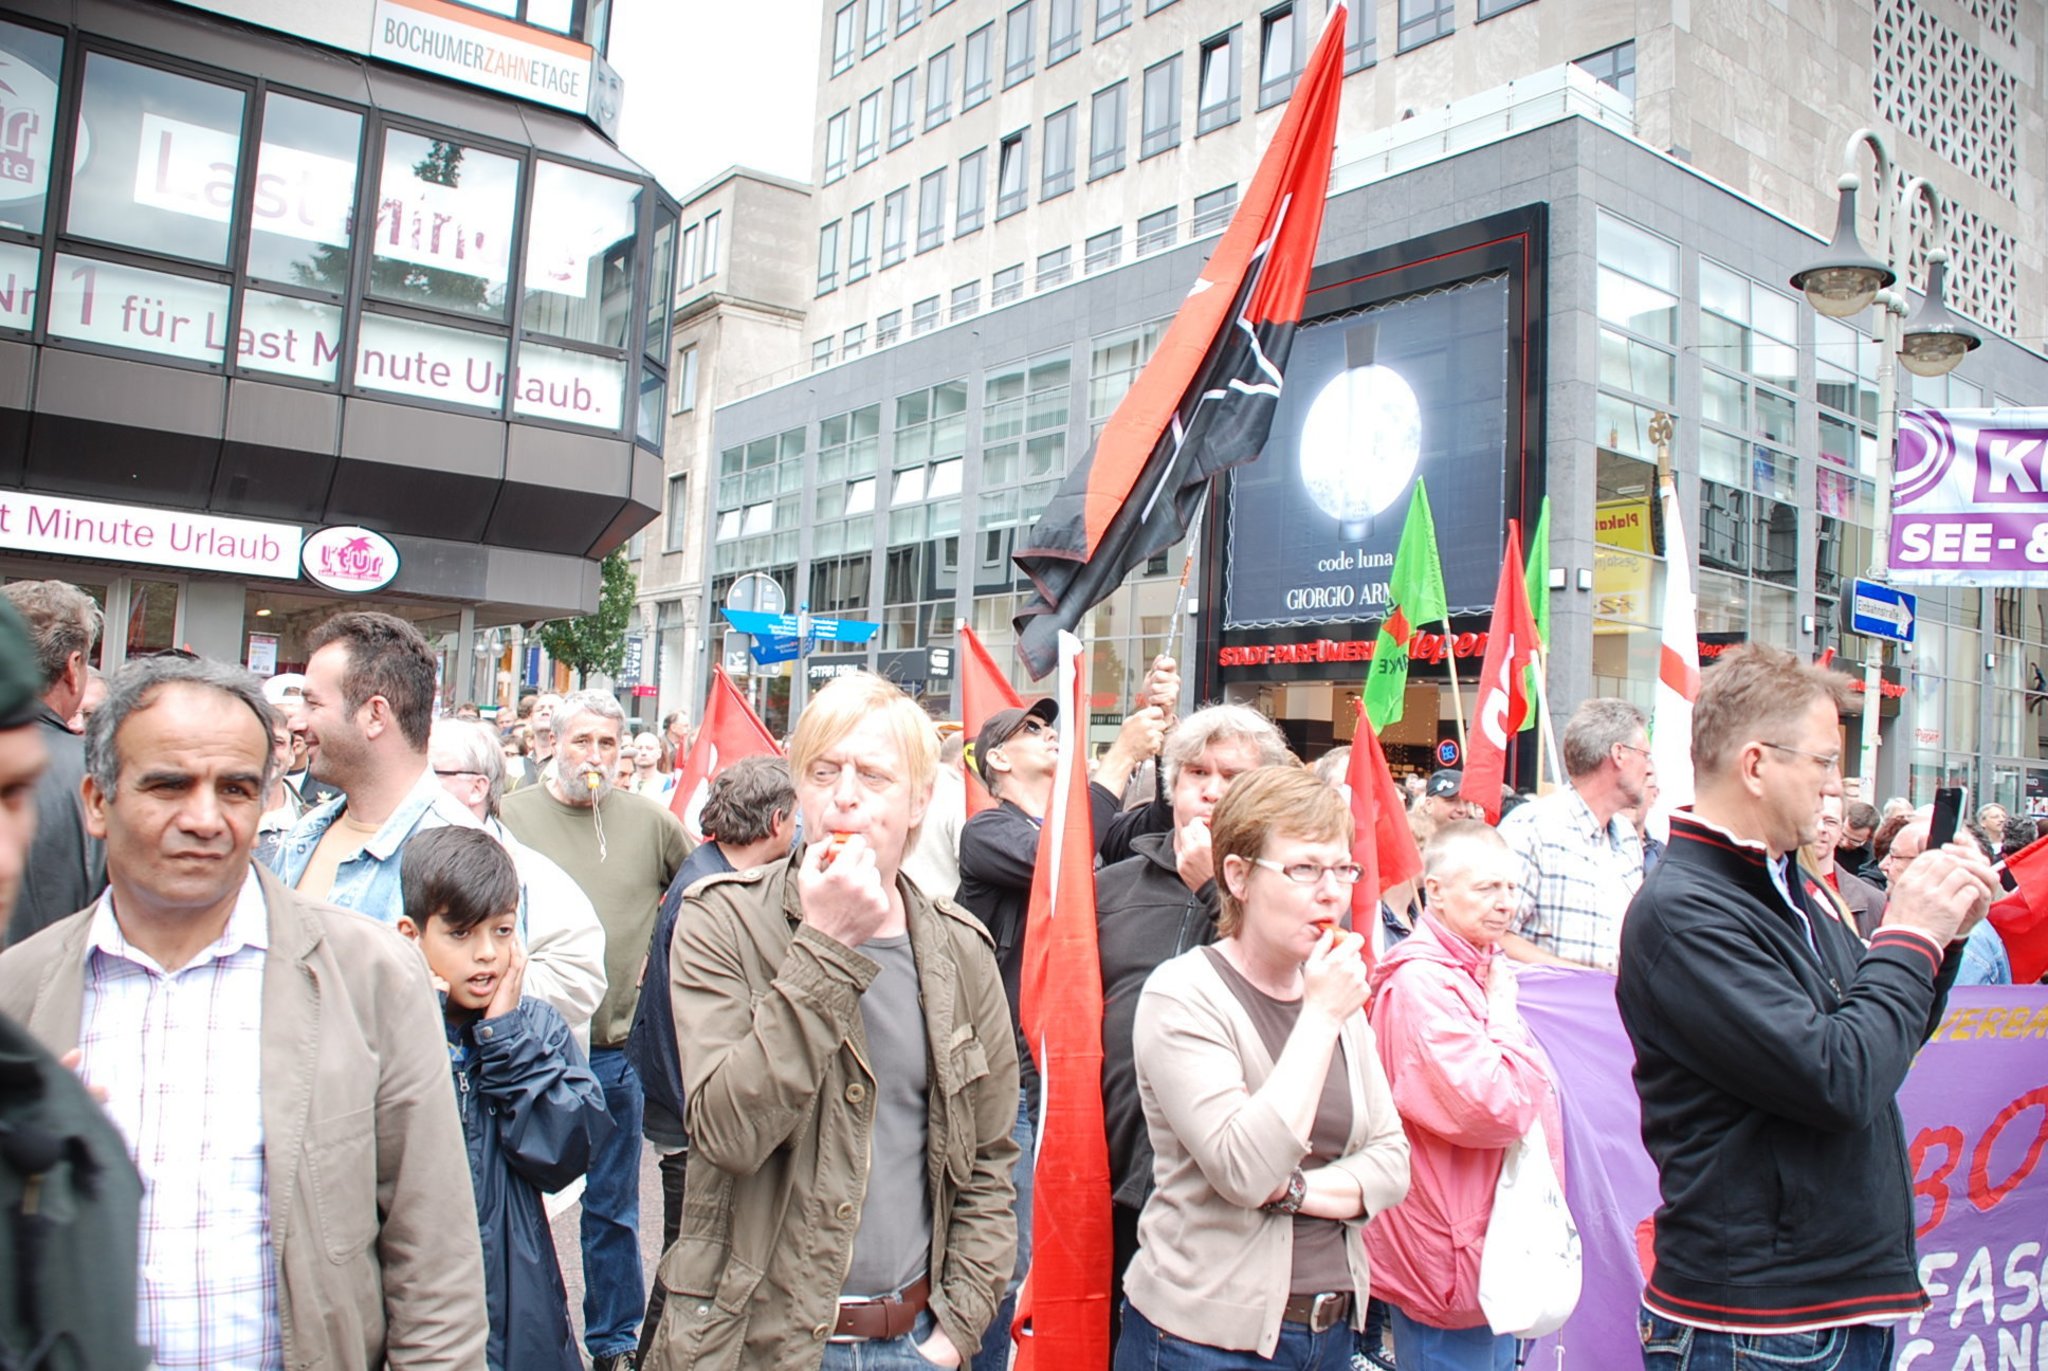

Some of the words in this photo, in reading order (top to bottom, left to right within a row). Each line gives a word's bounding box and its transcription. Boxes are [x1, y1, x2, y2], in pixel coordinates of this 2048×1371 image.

[384, 17, 580, 97] BOCHUMERZAHNETAGE
[71, 264, 97, 326] 1
[121, 294, 191, 343] für
[205, 312, 298, 363] Last
[313, 331, 451, 388] Mnute
[1988, 439, 2048, 494] K
[27, 505, 155, 548] Minute
[170, 522, 281, 562] Urlaub
[1318, 550, 1354, 573] code
[1358, 548, 1394, 569] luna
[1286, 584, 1355, 610] GIORGIO
[1220, 639, 1378, 667] STADT-PARFÜMERI
[1907, 1241, 2048, 1335] FAS
